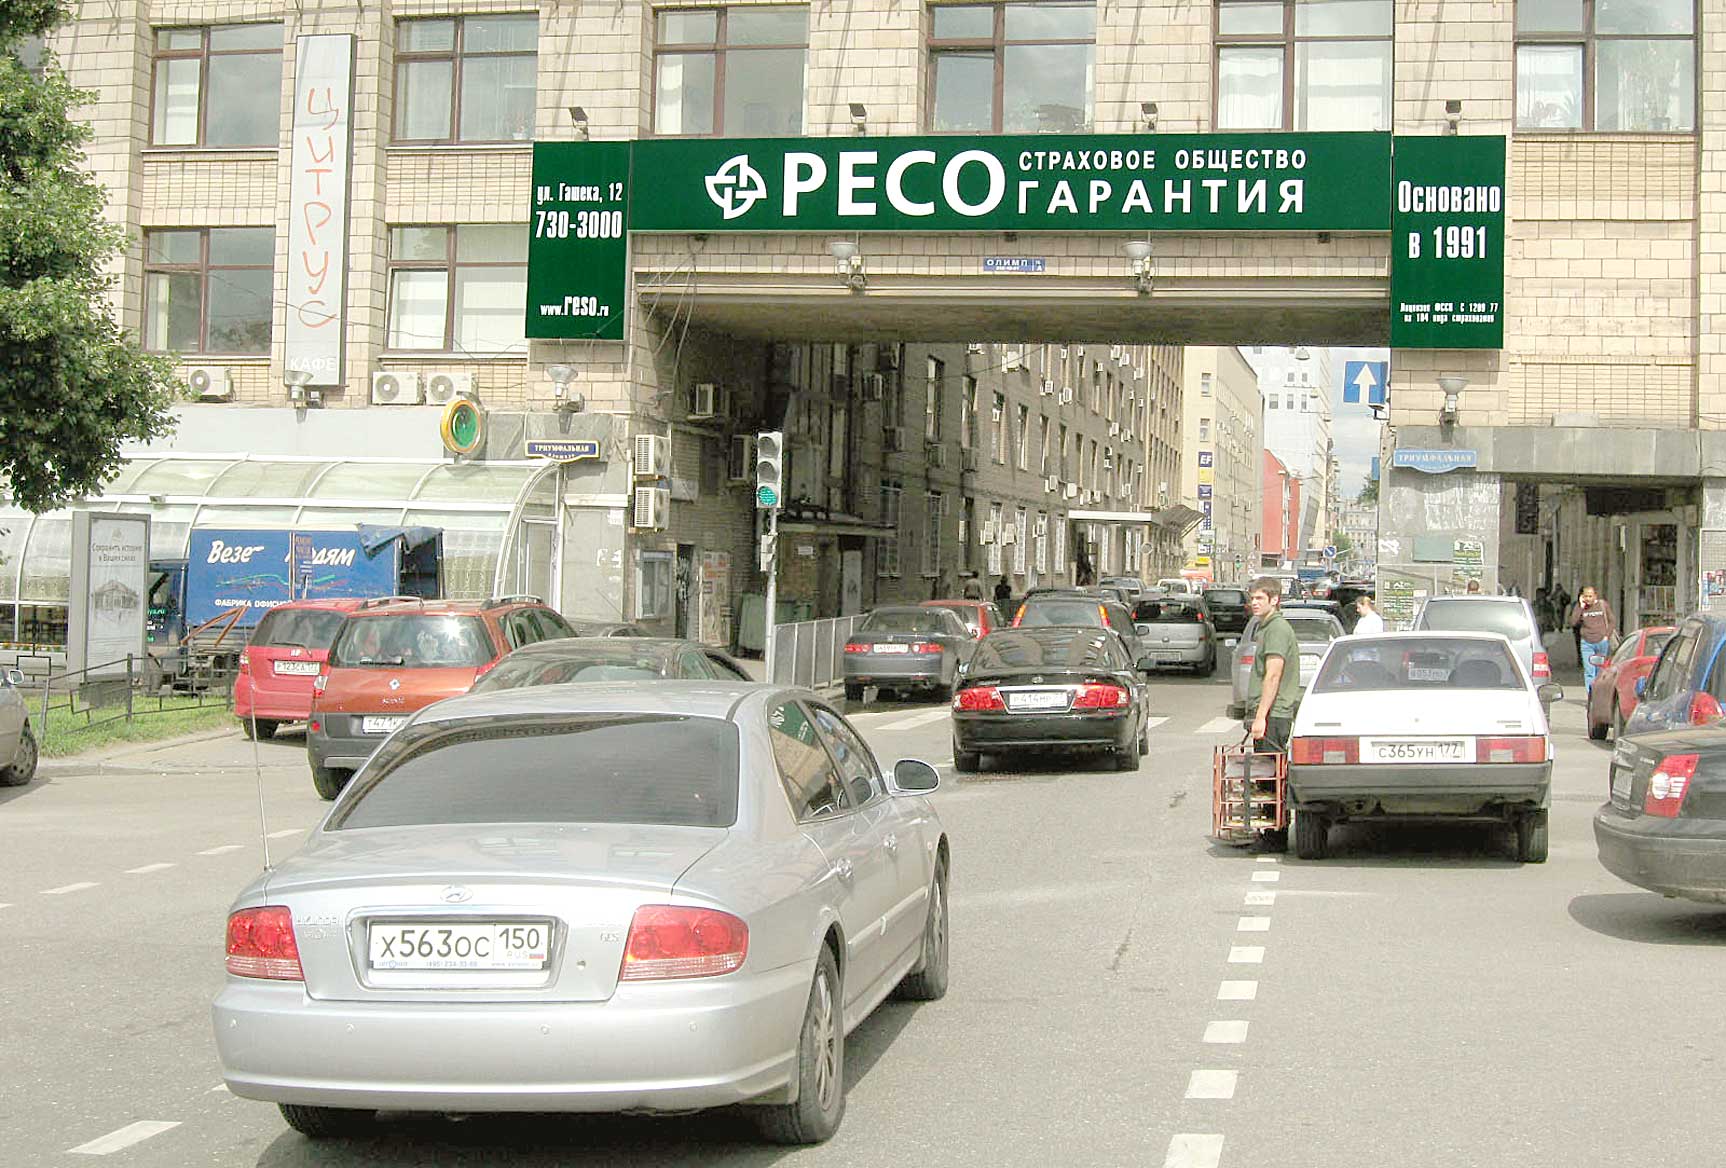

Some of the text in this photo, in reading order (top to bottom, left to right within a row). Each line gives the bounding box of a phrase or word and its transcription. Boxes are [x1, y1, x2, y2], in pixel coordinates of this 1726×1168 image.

[1018, 149, 1307, 173] СТРАХОВОЕ ОБЩЕСТВО
[537, 182, 623, 205] ул. Гашека, 12
[782, 149, 1006, 217] РЕСО
[298, 87, 339, 328] ЦИТРУС
[1018, 179, 1305, 214] ГАРАНТИЯ
[1398, 180, 1501, 213] Основано
[535, 210, 623, 239] 730-3000
[1433, 226, 1486, 259] 1991
[540, 296, 609, 317] www.reso.ru
[1490, 302, 1499, 312] 77
[290, 357, 336, 372] КАФЕ
[214, 599, 252, 607] ФАБРИКА
[1378, 743, 1459, 758] С365УН 177
[380, 928, 540, 958] Х563ОС 150
